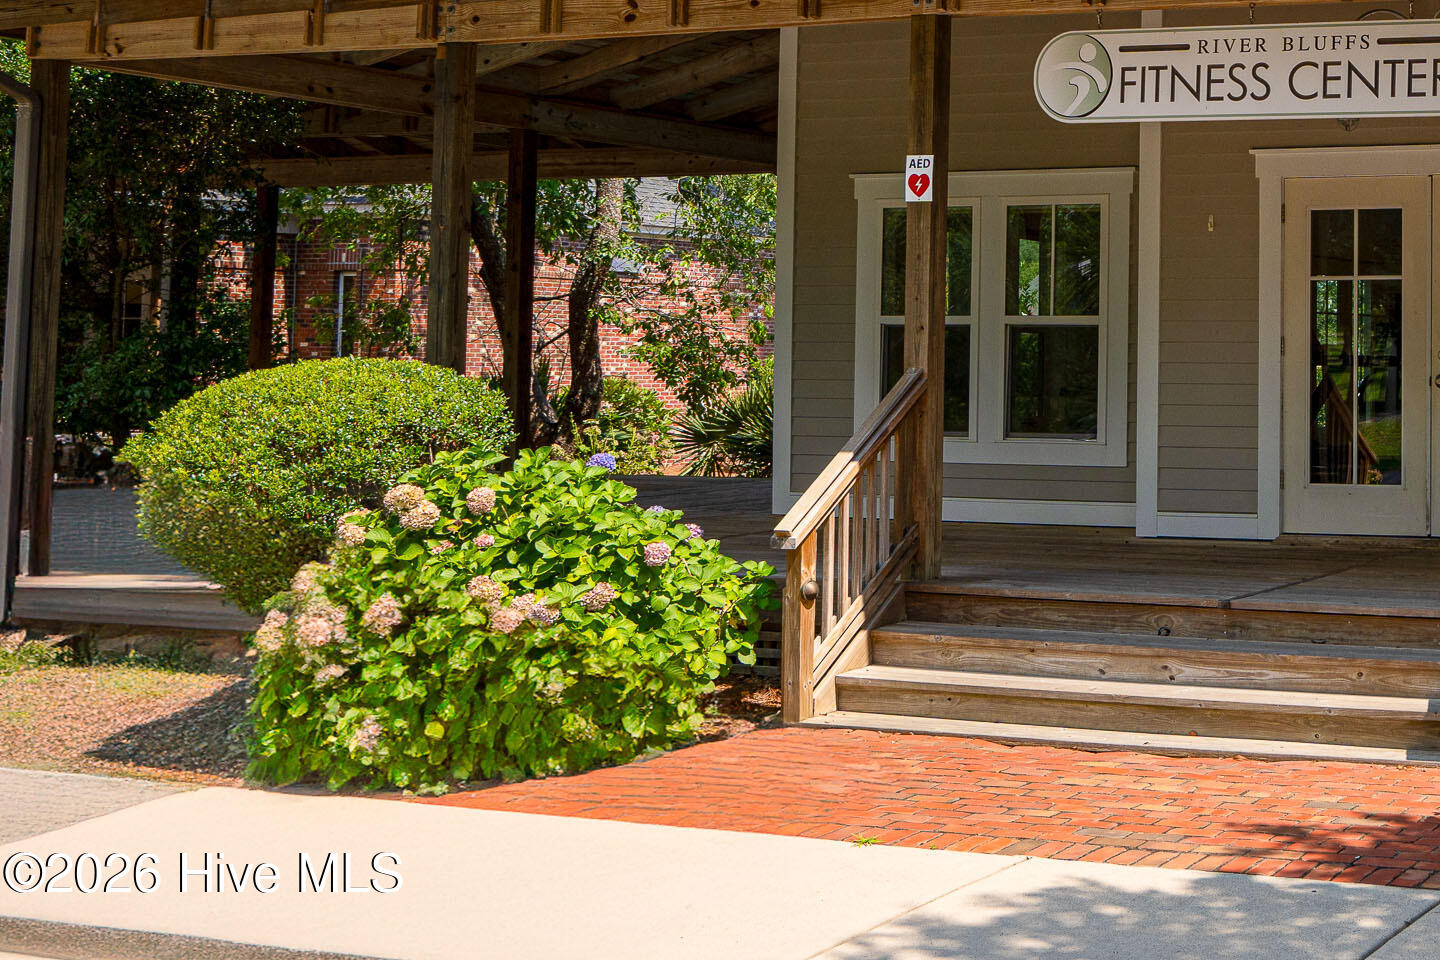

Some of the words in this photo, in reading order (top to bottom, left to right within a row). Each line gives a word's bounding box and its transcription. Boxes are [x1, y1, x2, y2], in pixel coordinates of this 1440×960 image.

[1197, 37, 1267, 54] RIVER
[1282, 34, 1370, 52] BLUFFS
[1120, 62, 1271, 103] FITNESS
[909, 158, 931, 169] AED
